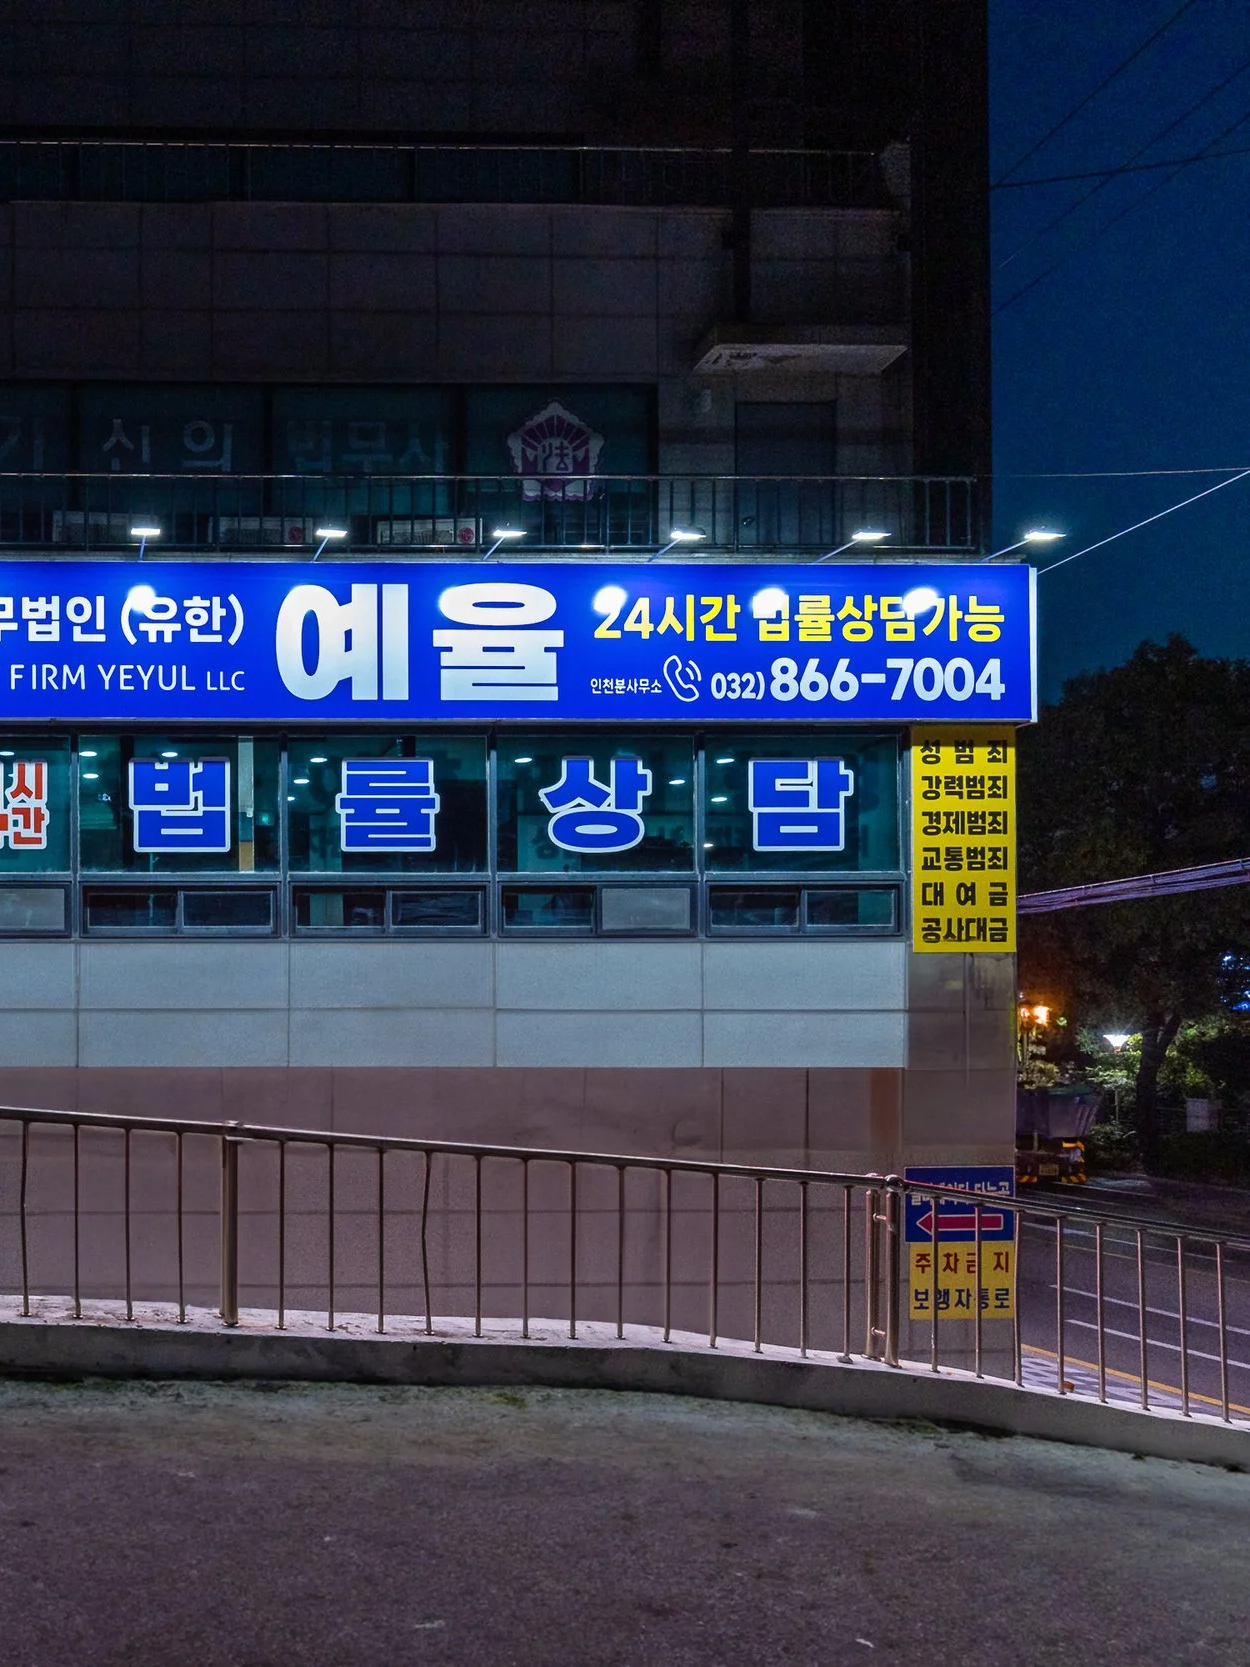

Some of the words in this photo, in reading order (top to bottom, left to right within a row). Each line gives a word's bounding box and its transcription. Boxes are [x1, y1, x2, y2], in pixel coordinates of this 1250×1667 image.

[121, 593, 245, 646] (유한)
[593, 594, 741, 642] 24시간
[275, 582, 565, 701] 예율
[10, 664, 87, 691] FIRM
[97, 664, 196, 691] YEYUL
[206, 671, 245, 691] LLC
[590, 678, 662, 695] 인천분사무소
[920, 739, 1008, 765] 성범죄
[921, 775, 1008, 800] 강력범죄
[921, 810, 1008, 836] 경제범죄
[921, 846, 1008, 872] 교통범죄
[921, 881, 1008, 907] 대여금
[921, 917, 1008, 944] 공사대금
